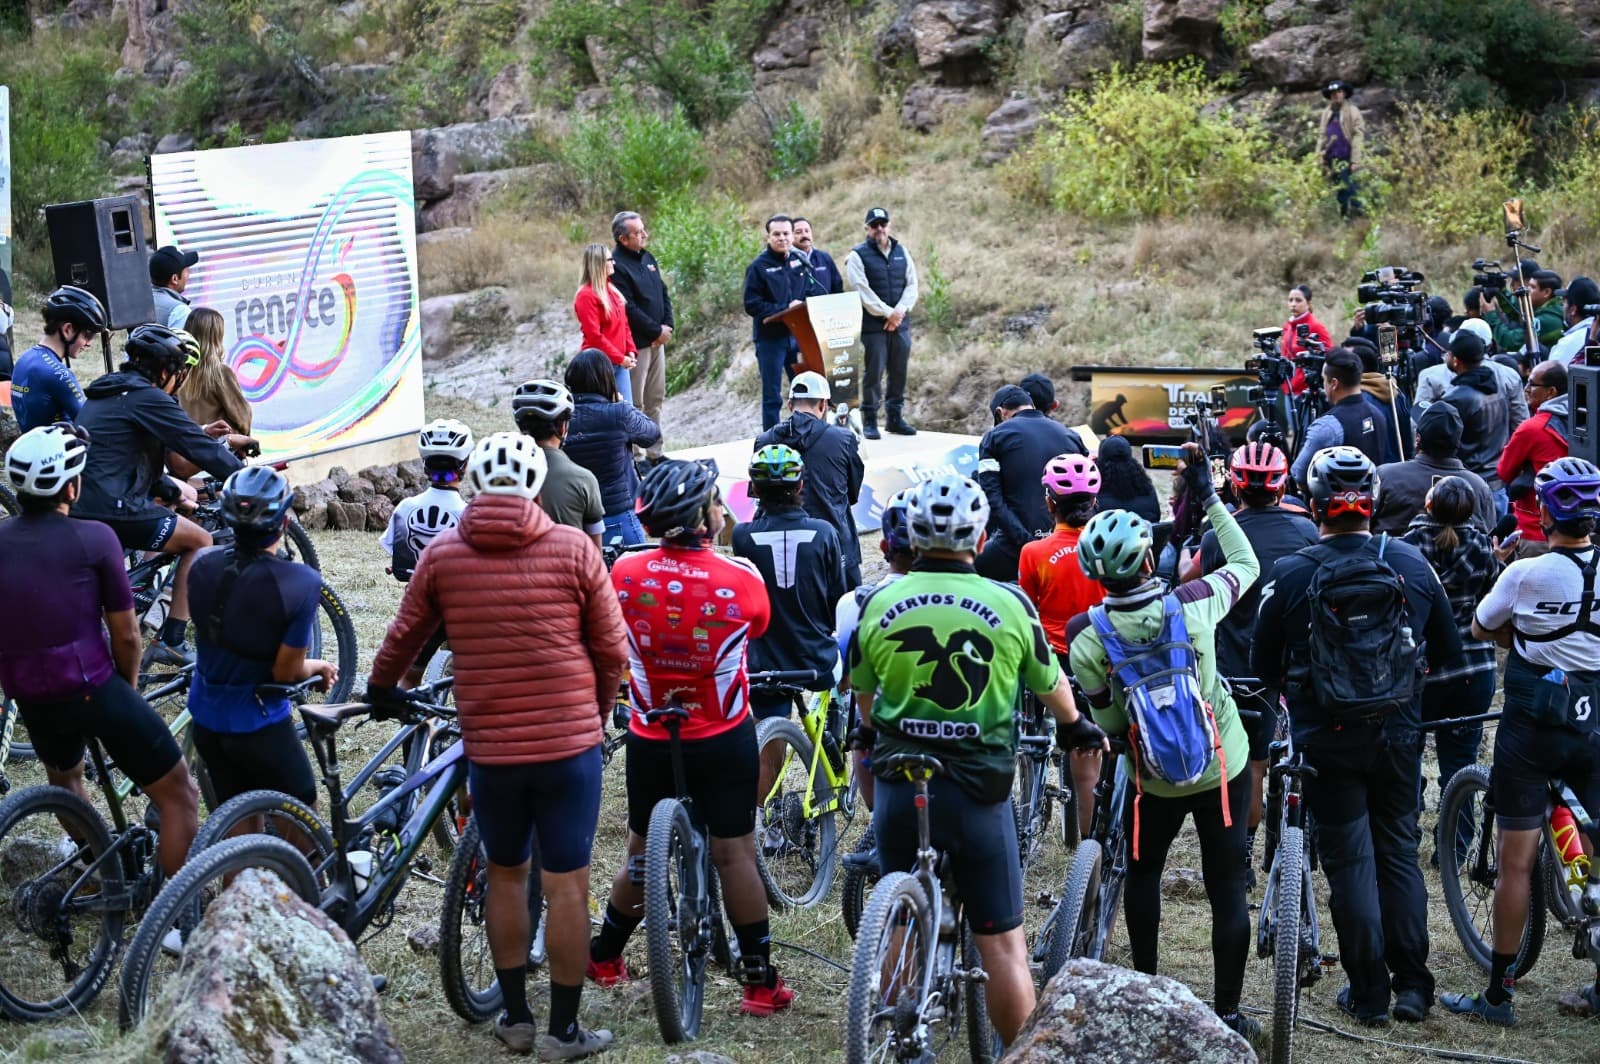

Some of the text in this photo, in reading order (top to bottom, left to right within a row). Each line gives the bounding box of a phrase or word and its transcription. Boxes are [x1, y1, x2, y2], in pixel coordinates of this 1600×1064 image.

[242, 271, 318, 291] DURAN
[1168, 407, 1212, 416] DESR
[1049, 545, 1078, 565] DURA
[879, 594, 1001, 630] CUERVOS BIKE
[901, 719, 978, 738] MTB DGO
[282, 801, 321, 830] MAXXIS
